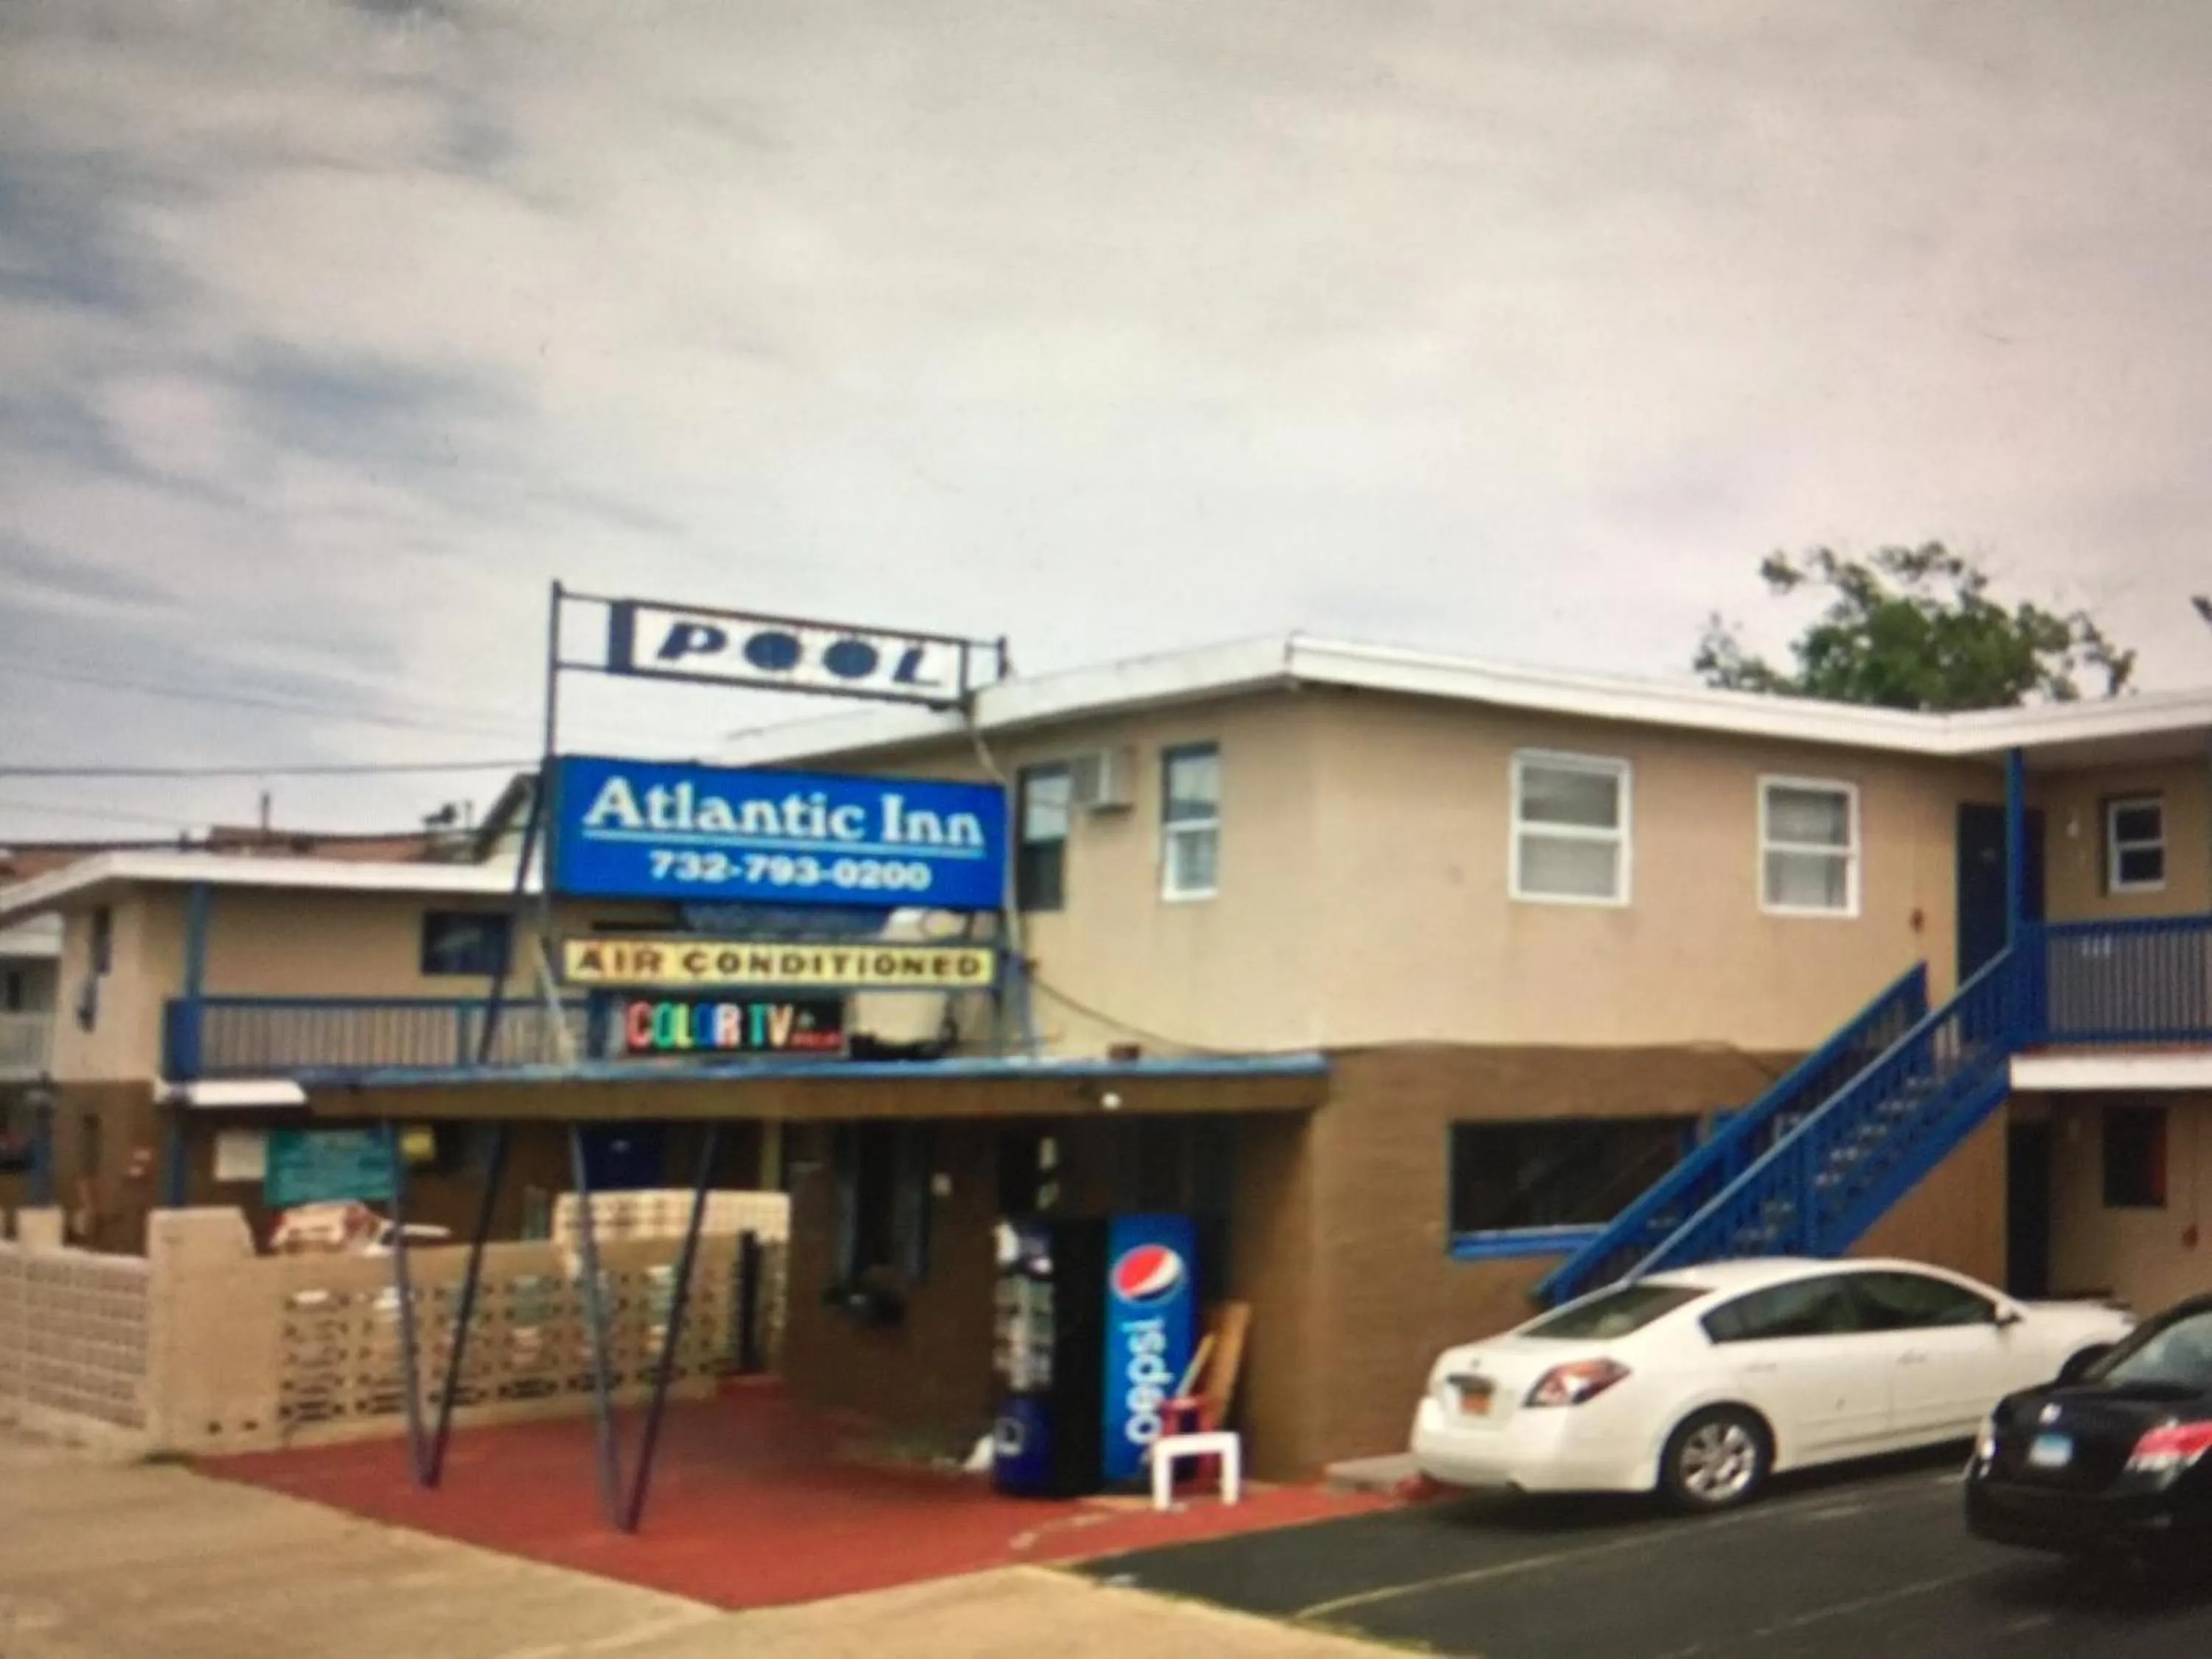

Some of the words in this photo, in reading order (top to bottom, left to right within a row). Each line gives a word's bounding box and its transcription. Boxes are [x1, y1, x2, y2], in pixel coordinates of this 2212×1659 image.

[658, 621, 943, 687] POOL
[582, 776, 865, 841] Atlantic
[880, 794, 984, 847] Inn
[649, 849, 931, 891] 732-793-0200
[577, 943, 664, 974] AIR
[683, 944, 981, 977] CONDITIONED
[625, 1001, 742, 1048] COLOR
[748, 1003, 794, 1048] TV
[1123, 1317, 1174, 1446] pepsi
